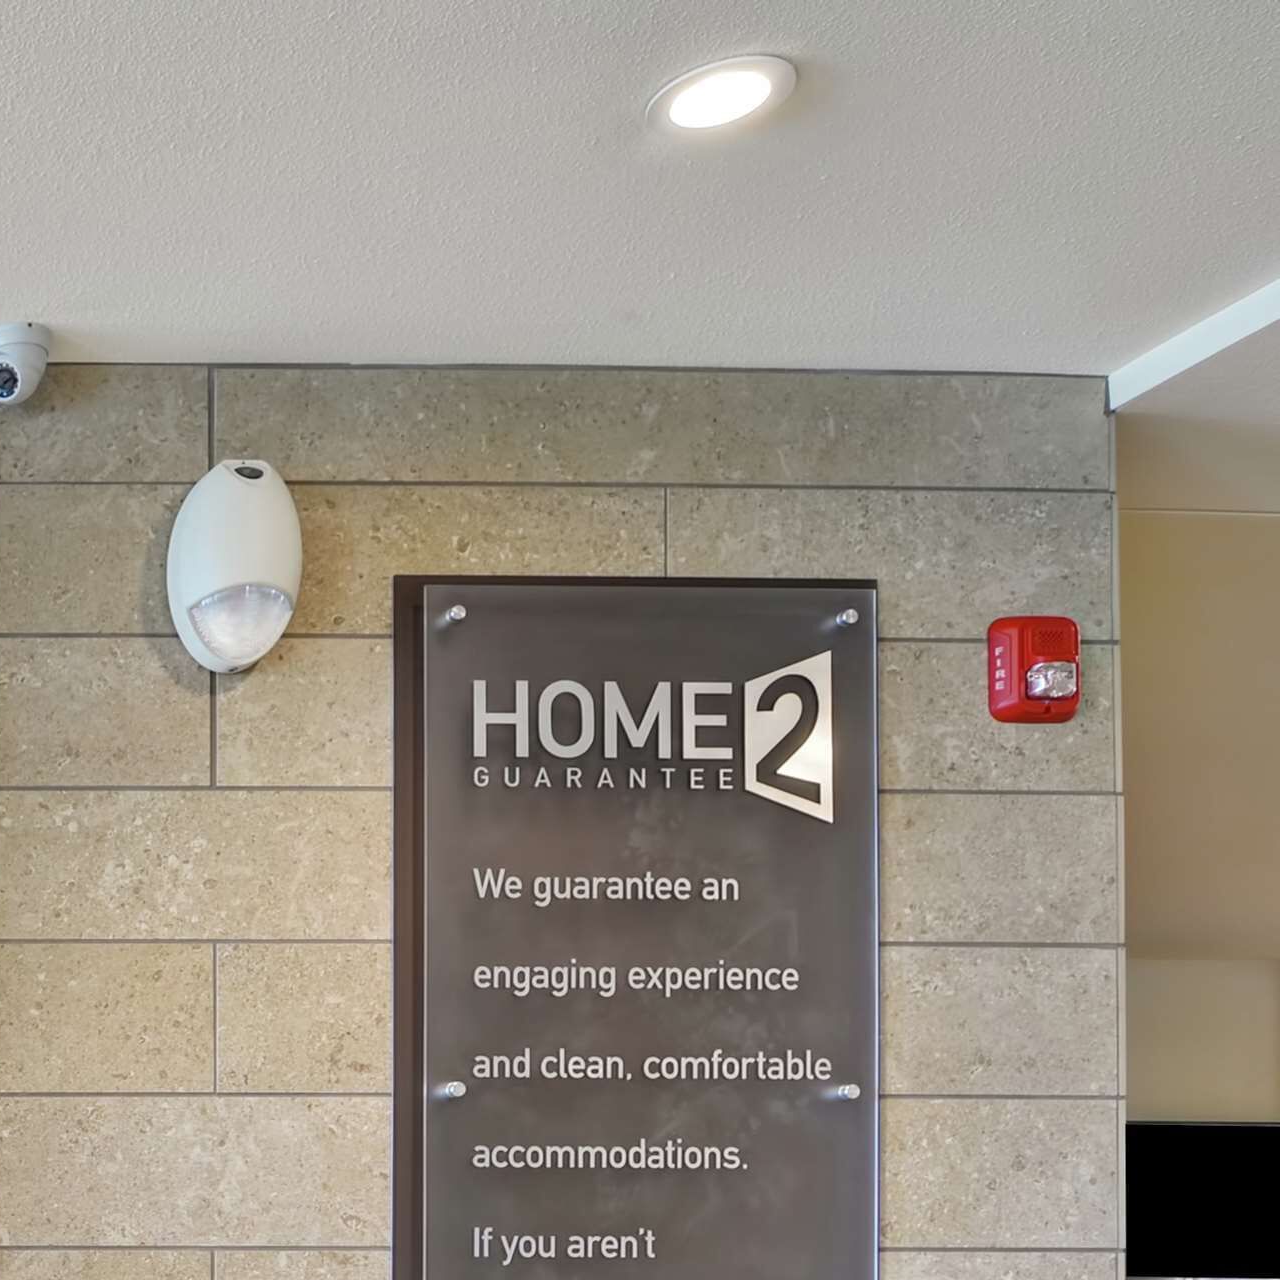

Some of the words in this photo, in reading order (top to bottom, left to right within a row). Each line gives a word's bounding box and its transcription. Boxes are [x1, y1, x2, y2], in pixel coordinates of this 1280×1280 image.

[994, 646, 1006, 691] FIRE
[473, 766, 734, 790] GUARANTEE
[473, 867, 523, 899] We
[533, 871, 692, 907] guarantee
[702, 877, 739, 901] an
[473, 958, 616, 998] engaging
[628, 959, 800, 998] experience
[472, 1047, 531, 1078] and
[540, 1047, 632, 1081] clean,
[643, 1048, 832, 1081] comfortable
[472, 1138, 748, 1170] accommodations.
[473, 1227, 493, 1258] If
[501, 1235, 556, 1266] you
[567, 1227, 656, 1258] aren't
